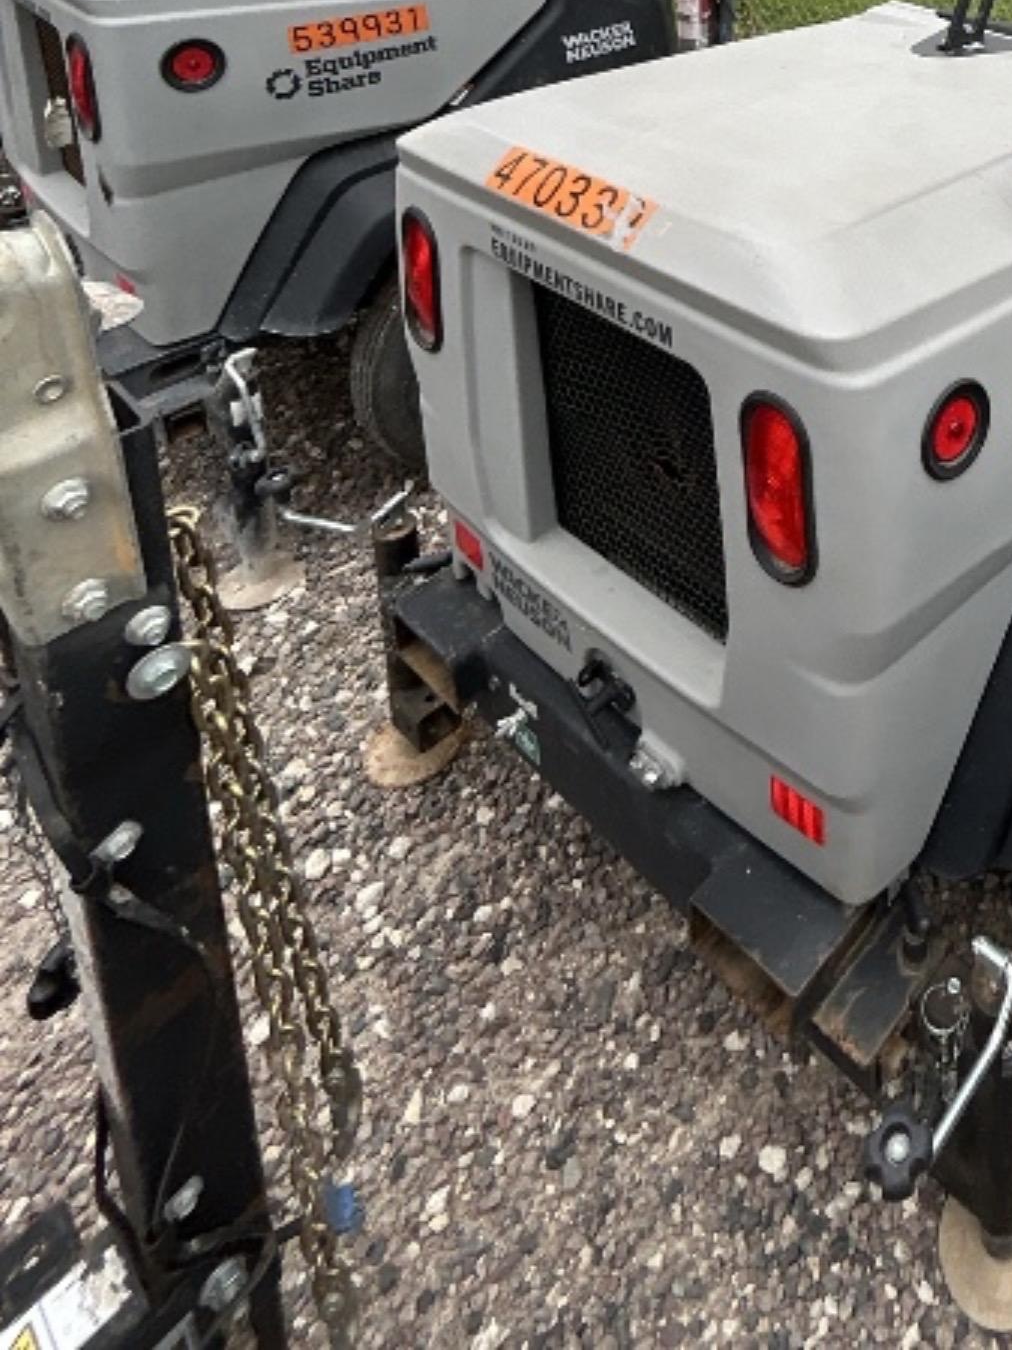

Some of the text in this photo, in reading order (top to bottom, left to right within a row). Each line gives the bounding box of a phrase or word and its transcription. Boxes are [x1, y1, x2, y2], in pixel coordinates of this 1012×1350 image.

[305, 35, 438, 78] Equipment
[308, 70, 382, 98] Share
[491, 236, 674, 348] EQUIPMENTSHARE.COM
